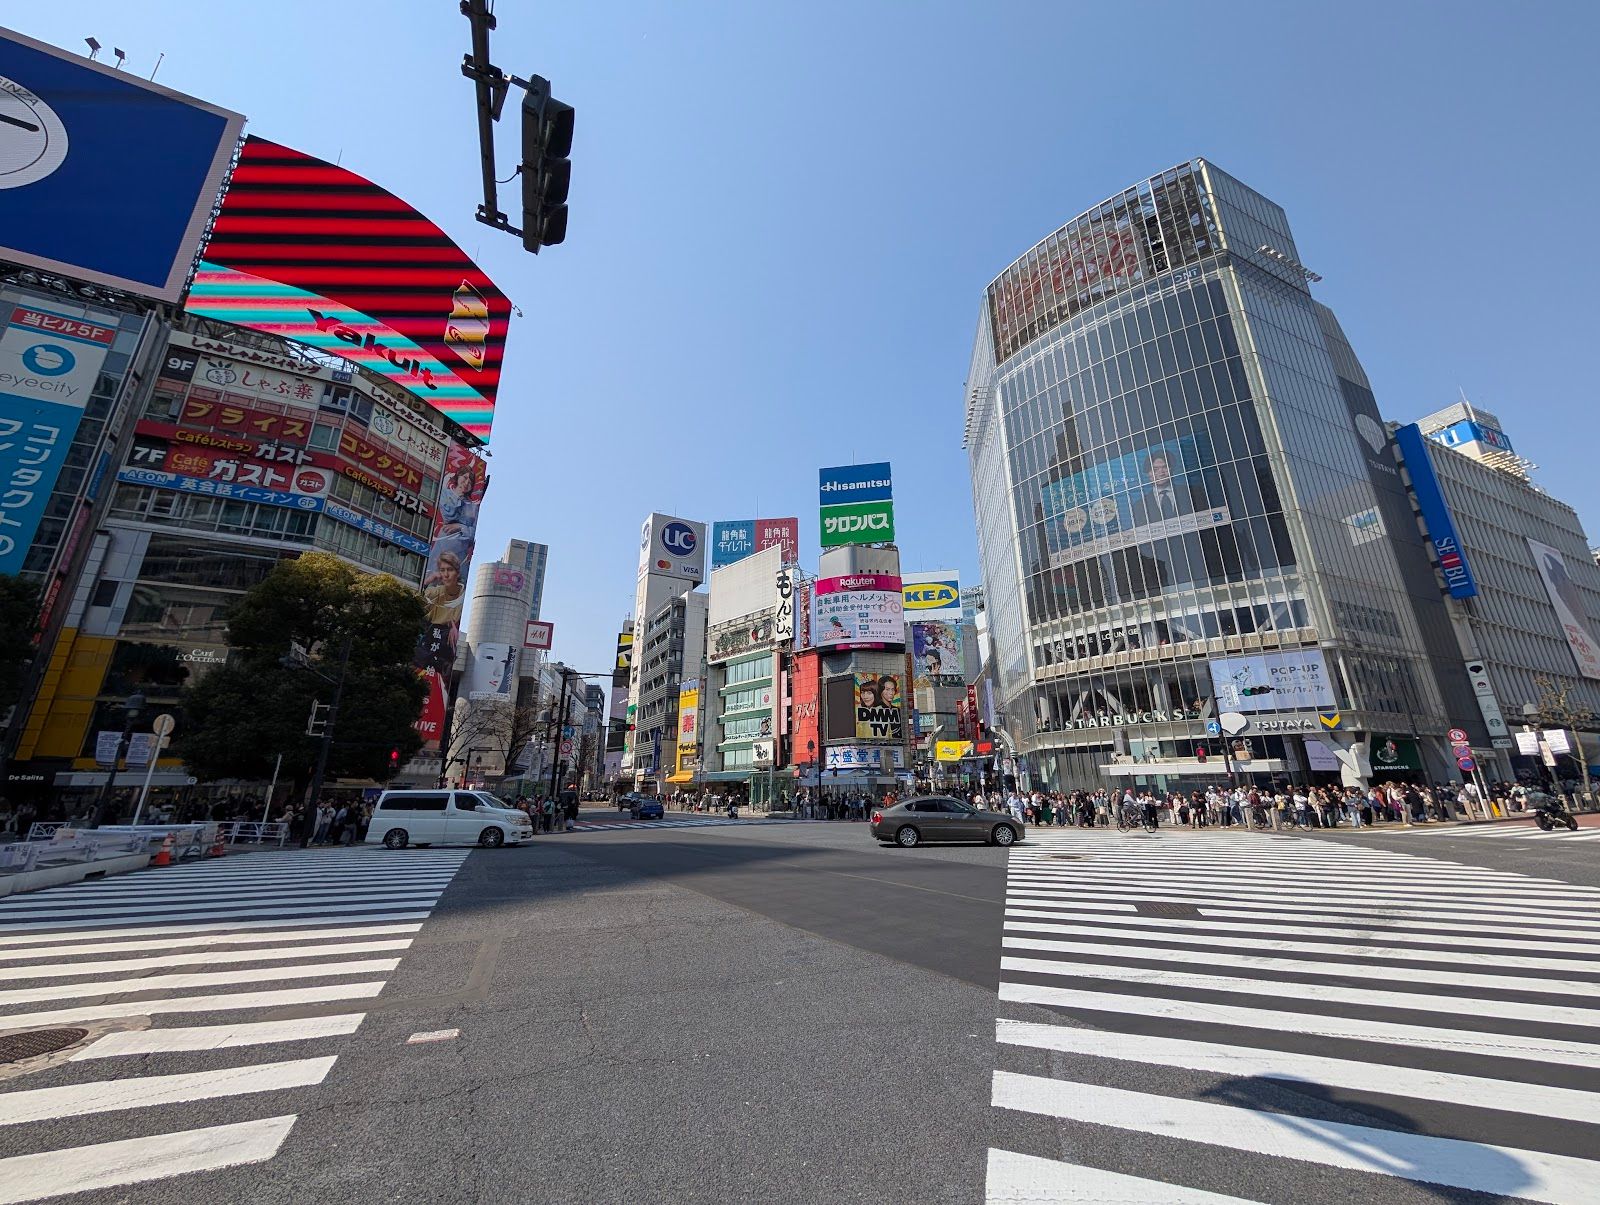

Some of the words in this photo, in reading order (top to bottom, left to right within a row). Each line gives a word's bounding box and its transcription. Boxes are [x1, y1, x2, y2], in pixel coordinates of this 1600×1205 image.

[22, 312, 104, 338] 当ビル5F
[307, 308, 428, 390] Yakult
[167, 357, 195, 371] 9F
[0, 373, 80, 397] eyecity
[241, 370, 314, 400] しゃぶ葉
[186, 401, 306, 438] プライス
[133, 446, 167, 463] 7F
[172, 453, 209, 466] Café
[255, 442, 313, 465] ガスト
[341, 433, 419, 485] コンタクト
[209, 458, 286, 487] ガスト
[1368, 459, 1397, 476] TSUTAYA
[127, 469, 168, 484] AEON
[300, 498, 317, 508] 6F
[299, 479, 323, 488] ガスト
[821, 479, 891, 492] Hisamitsu
[394, 489, 429, 514] ガスト
[329, 504, 360, 522] AEON
[824, 512, 890, 534] サロンパス
[682, 566, 700, 575] VISA
[1435, 536, 1469, 588] SEIBU
[840, 577, 876, 587] Rakuten
[776, 569, 793, 638] もんじゃ
[817, 593, 889, 608] 自転車用ヘルメット
[529, 631, 546, 640] H&M
[1270, 663, 1319, 676] POP-UP
[857, 706, 900, 723] DMM
[1064, 707, 1184, 731] STARBUCKS
[869, 723, 889, 737] TV
[1254, 718, 1313, 730] TSUTAYA
